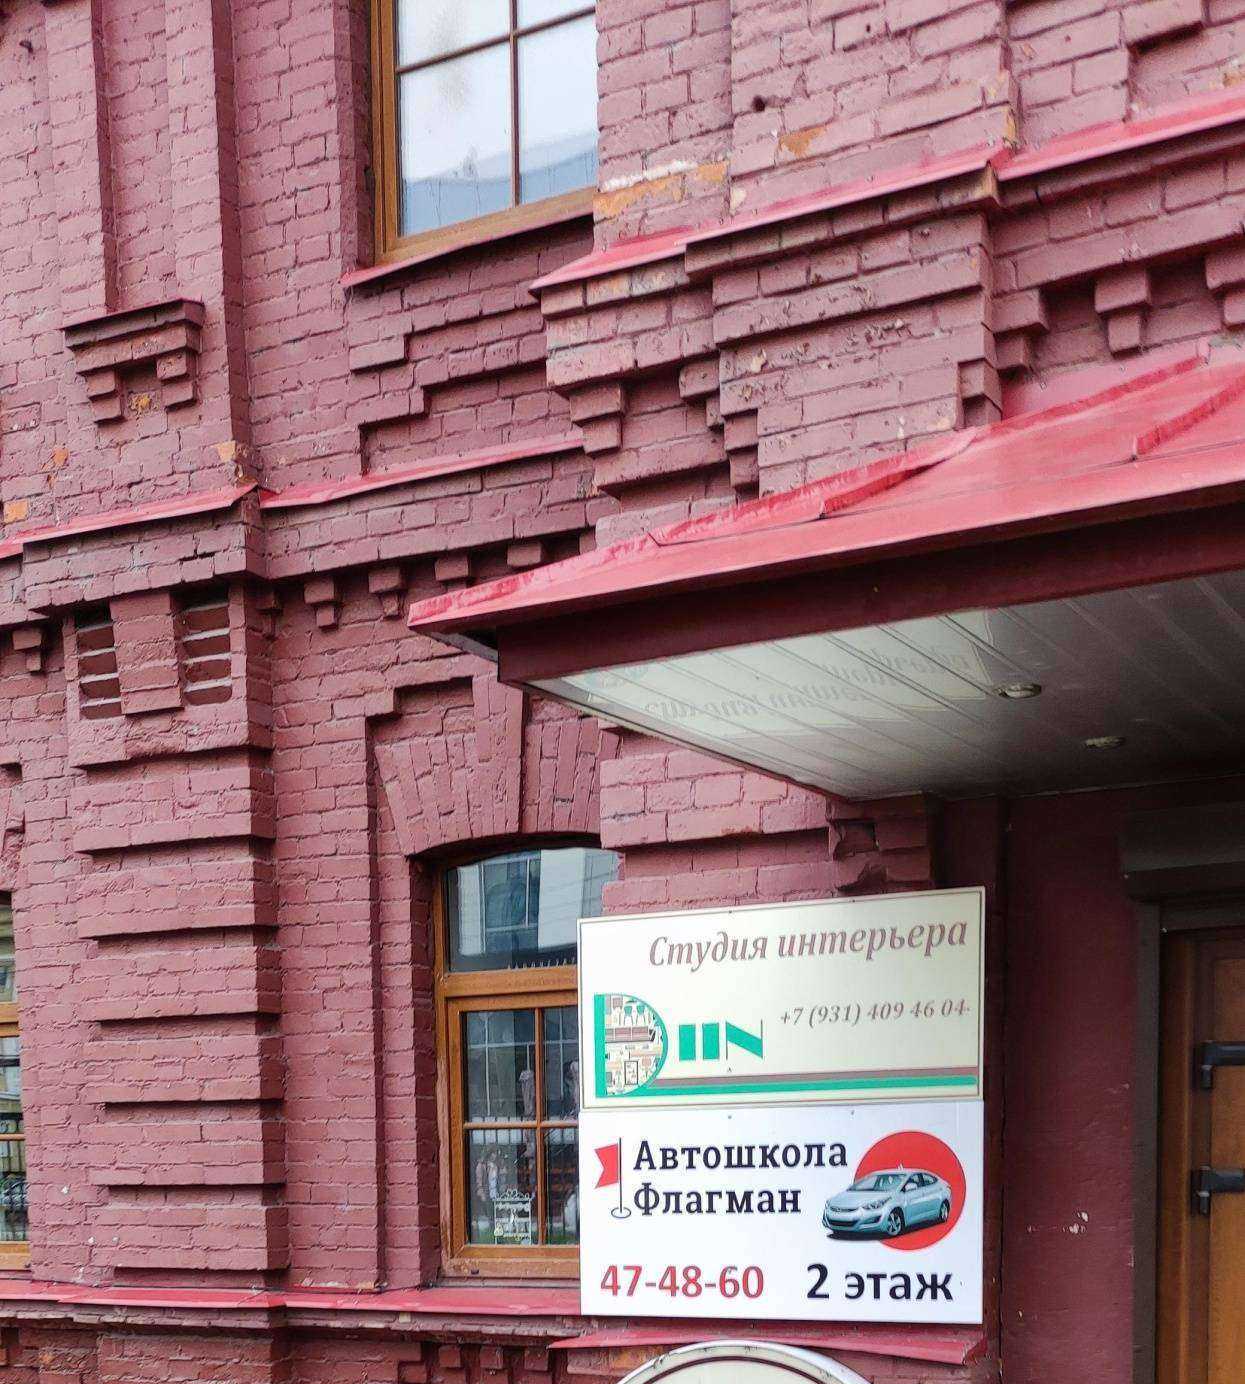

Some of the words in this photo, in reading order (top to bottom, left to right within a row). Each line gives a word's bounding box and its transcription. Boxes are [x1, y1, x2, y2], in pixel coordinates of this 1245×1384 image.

[649, 931, 768, 972] Студия
[777, 920, 968, 961] интерьера
[780, 1007, 804, 1026] +7
[808, 1003, 861, 1029] (931)
[867, 1001, 905, 1021] 409
[910, 1000, 935, 1019] 46
[632, 1139, 848, 1171] Автошкола
[633, 1181, 802, 1216] Флагман
[600, 1264, 764, 1299] 47-48-60
[806, 1263, 830, 1300] 2
[844, 1271, 954, 1301] этаж
